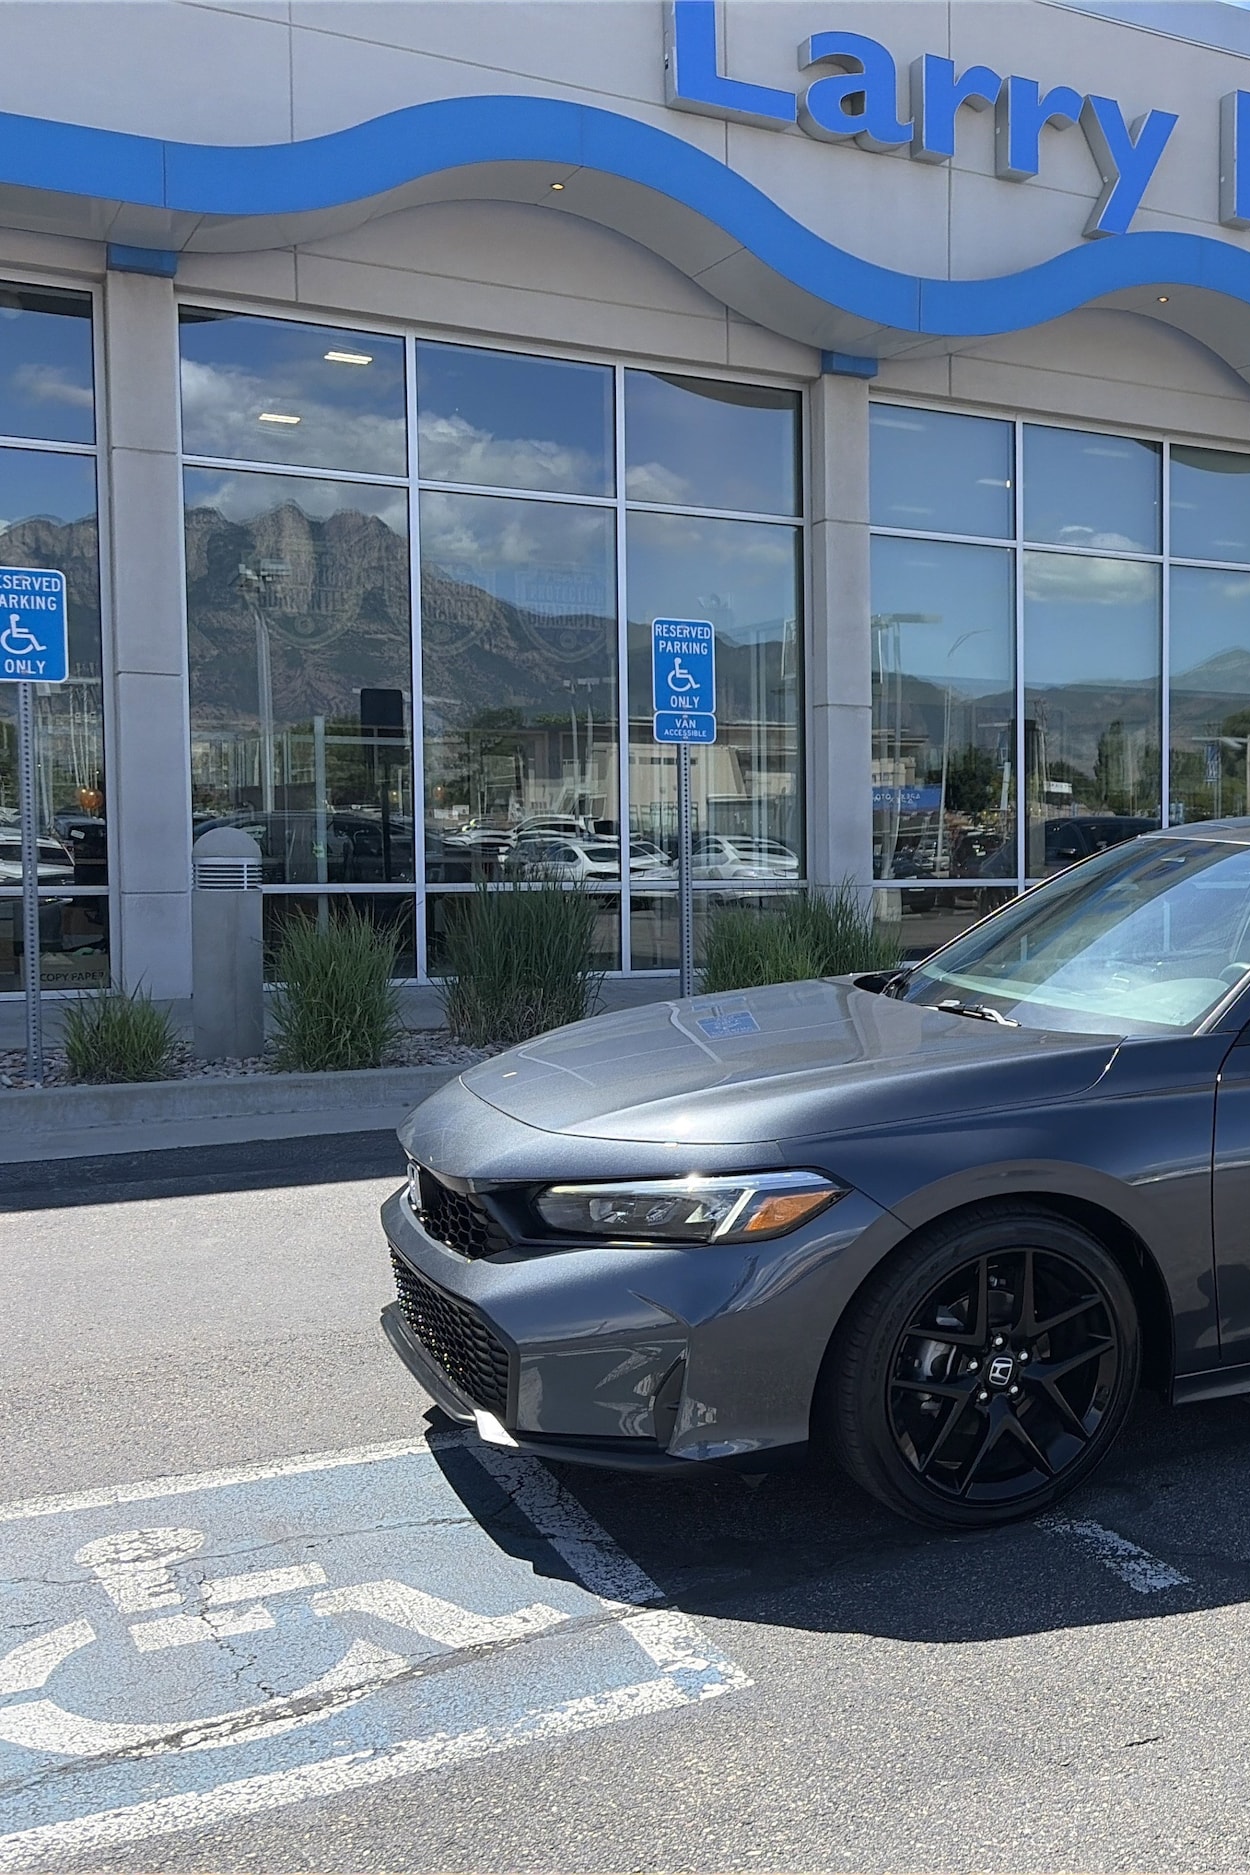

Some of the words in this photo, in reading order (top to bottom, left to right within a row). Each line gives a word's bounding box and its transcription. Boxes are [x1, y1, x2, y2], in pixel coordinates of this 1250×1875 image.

[667, 0, 1180, 237] Larry
[0, 574, 61, 592] SERVED
[0, 593, 57, 611] ARKING
[655, 624, 711, 639] RESERVED
[659, 640, 708, 655] PARKING
[4, 659, 46, 674] ONLY
[670, 695, 700, 708] ONLY
[675, 718, 696, 729] VAN
[664, 729, 707, 738] ACCESSIBLE
[40, 973, 69, 982] COPY
